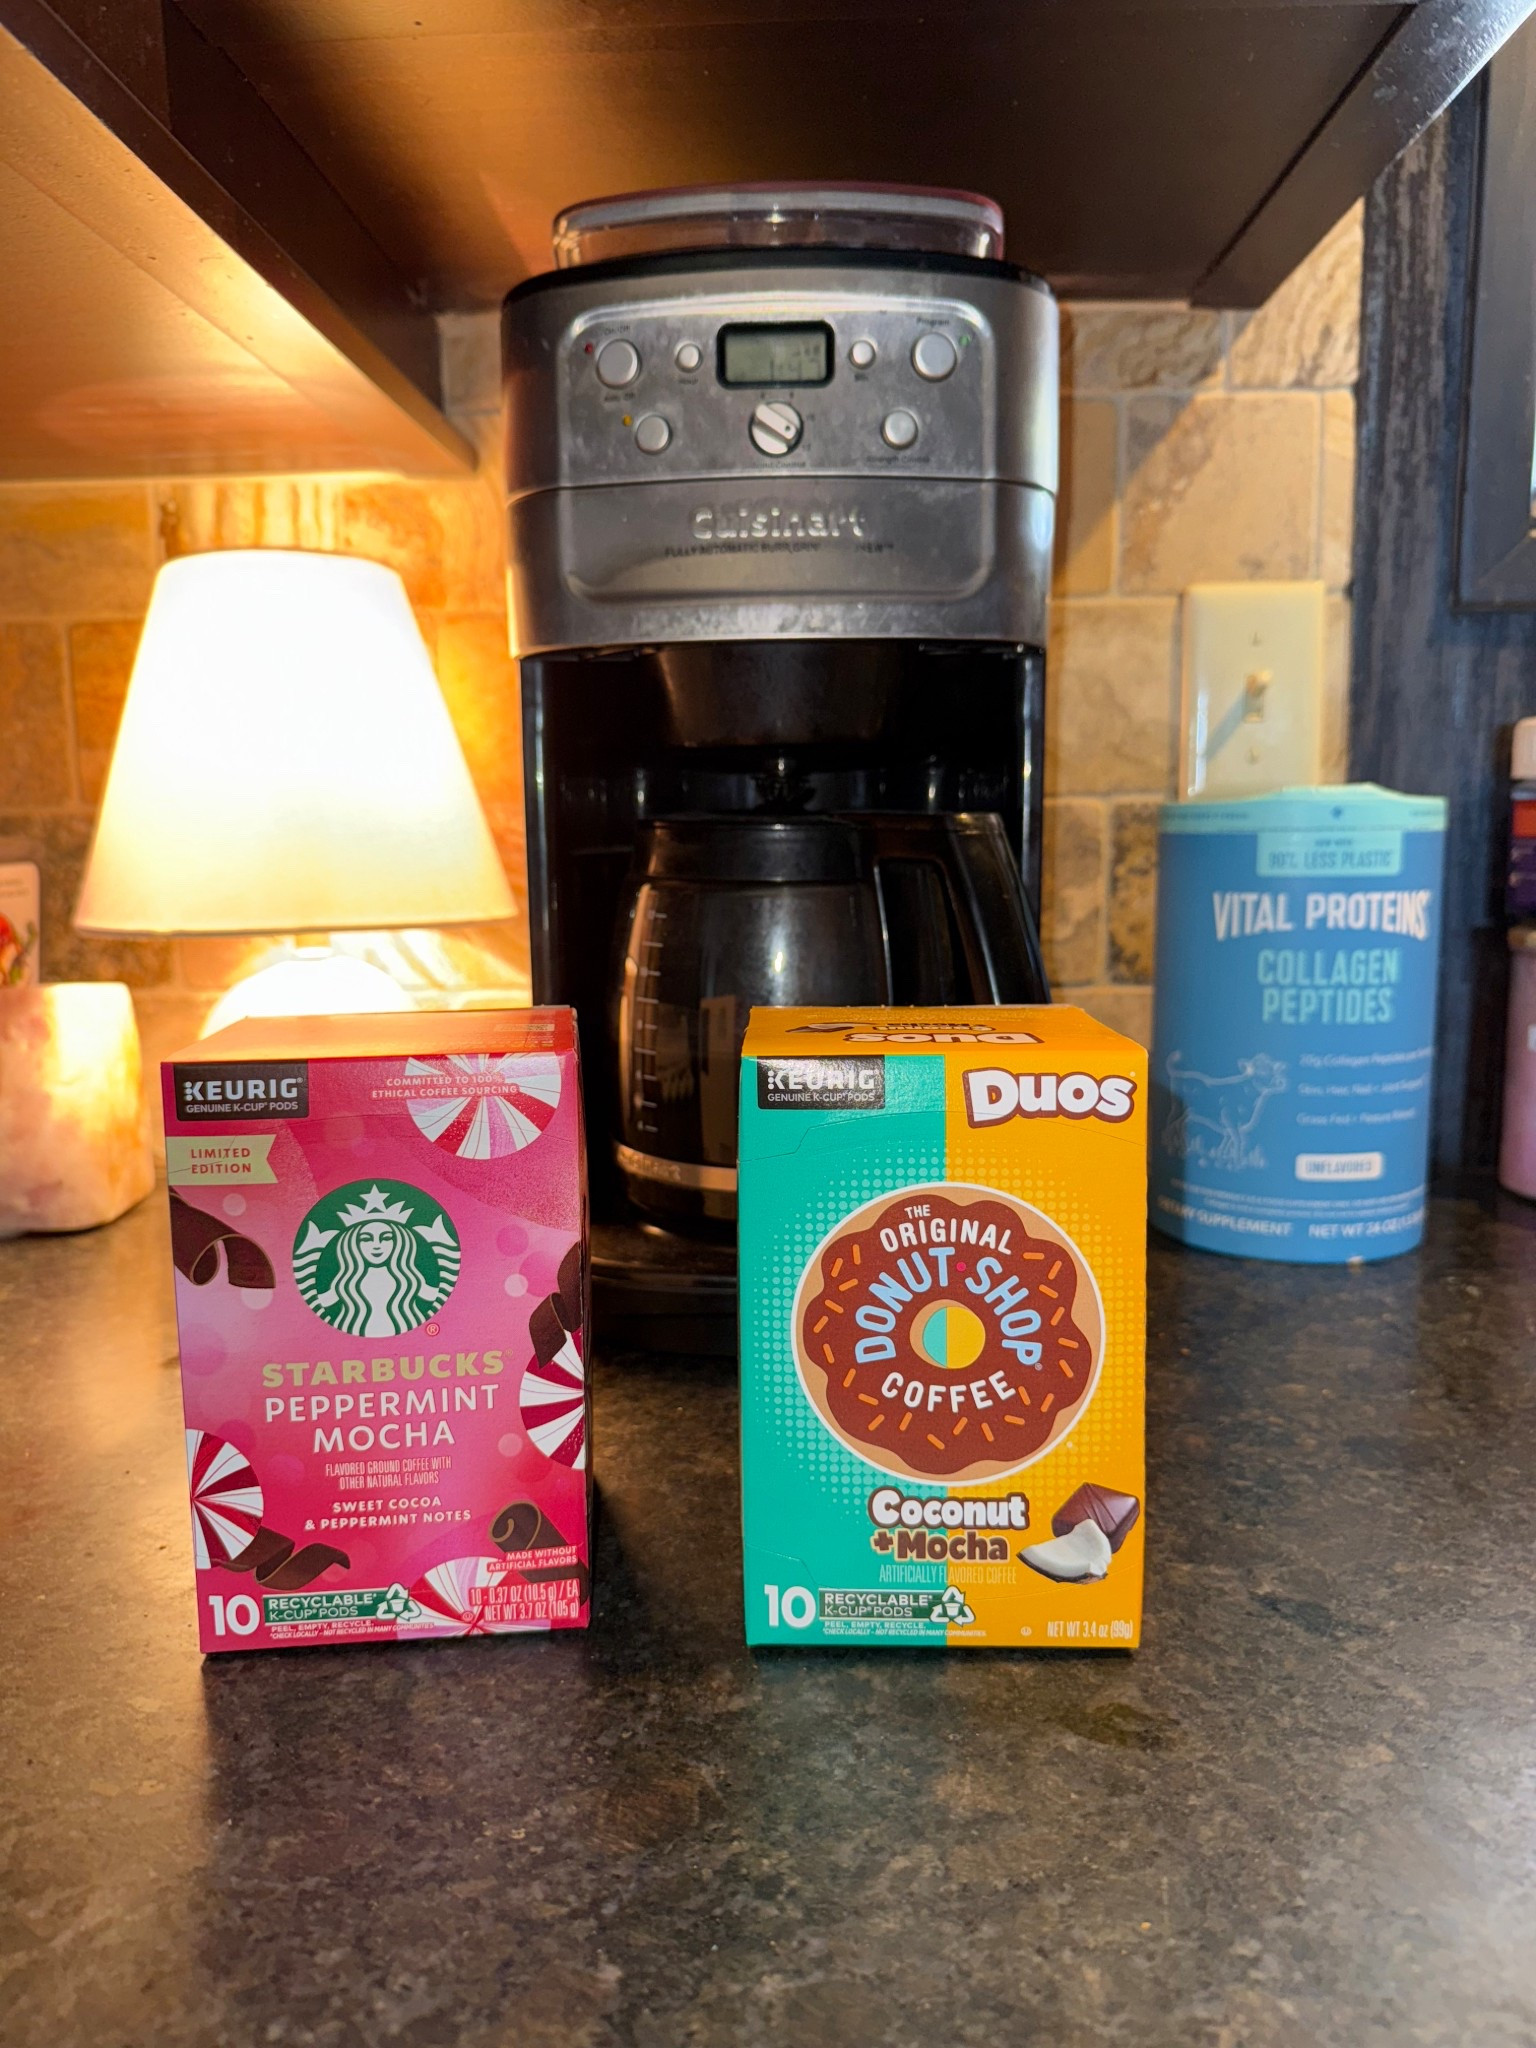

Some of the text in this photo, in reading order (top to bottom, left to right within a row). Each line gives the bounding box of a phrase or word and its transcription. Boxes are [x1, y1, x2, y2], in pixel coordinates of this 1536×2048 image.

[693, 506, 865, 540] Cuisinart
[1303, 850, 1336, 868] LESS
[1341, 849, 1393, 869] PLASTIC
[1212, 889, 1430, 941] VITAL PROTEINS
[1257, 948, 1400, 986] COLLAGEN
[1262, 986, 1394, 1024] PEPTIDES
[386, 1074, 504, 1087] COMMITTED TO 100%
[372, 1085, 518, 1098] ETHICAL COFFEE SOURCING
[768, 1093, 812, 1102] GENUINE
[848, 1092, 875, 1101] PODS
[186, 1103, 232, 1113] GENUINE
[269, 1101, 298, 1111] PODS
[190, 1147, 251, 1159] LIMITED
[191, 1163, 252, 1174] EDITION
[904, 1204, 932, 1219] THE
[879, 1217, 1012, 1256] ORIGINAL
[855, 1246, 1043, 1366] DONUT SHOP
[881, 1369, 1017, 1414] COFFEE
[265, 1383, 499, 1423] PEPPERMINT
[313, 1420, 456, 1453] MOCHA
[325, 1455, 452, 1477] FLAVORED GROUND COFFEE WITH
[339, 1471, 440, 1490] OTHER NATURAL FLAVORS
[332, 1496, 442, 1513] SWEET COCOA
[870, 1488, 1028, 1528] Coconut
[304, 1509, 471, 1531] & PEPPERMINT NOTES
[489, 1554, 577, 1571] ARTIFICIAL FLAVORS
[506, 1545, 577, 1560] MADE WITHOUT
[879, 1564, 1017, 1584] ARTIFICIALLY FLAVORED COFFEE
[470, 1587, 482, 1605] 10
[489, 1586, 508, 1604] 0.37
[510, 1585, 521, 1603] OZ
[524, 1582, 546, 1602] (10.5
[567, 1579, 579, 1598] EA
[208, 1594, 260, 1636] 10
[319, 1605, 359, 1618] PODS
[484, 1603, 501, 1620] NET
[503, 1602, 518, 1620] WT
[519, 1601, 533, 1619] 3.7
[535, 1600, 547, 1618] OZ
[549, 1599, 569, 1618] (105
[764, 1584, 817, 1628] 10
[873, 1606, 913, 1617] PODS
[271, 1619, 375, 1633] PEEL, EMPTY, RECYCLE.
[292, 1630, 319, 1639] LOCALLY
[323, 1628, 336, 1636] NOT
[336, 1627, 367, 1635] RECYCLED
[374, 1624, 393, 1632] MANY
[824, 1621, 926, 1630] PEEL, EMPTY, RECYCLE.
[888, 1628, 919, 1636] RECYCLED
[1047, 1619, 1133, 1640] NET WT 3.4 oz (99g)
